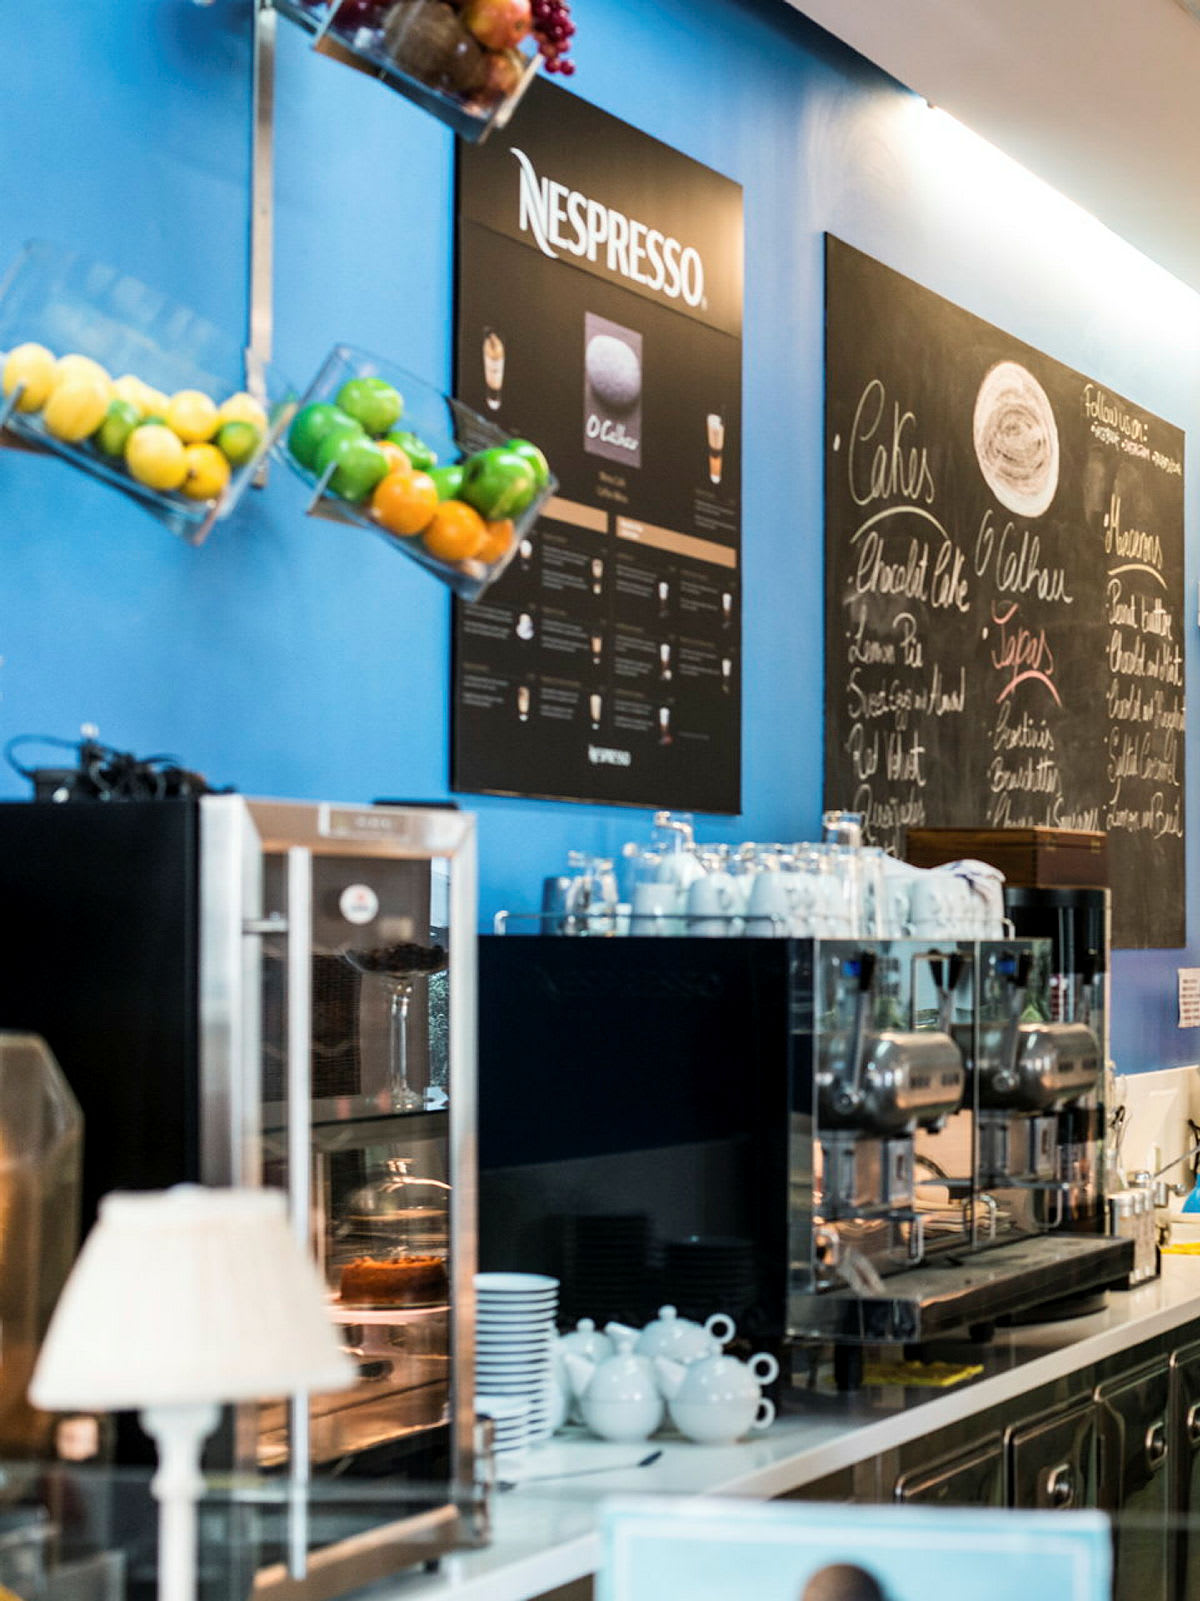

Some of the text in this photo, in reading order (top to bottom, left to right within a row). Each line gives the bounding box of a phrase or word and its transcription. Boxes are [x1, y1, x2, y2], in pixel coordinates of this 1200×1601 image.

[510, 147, 705, 308] NESPRESSO
[849, 379, 935, 505] Cakes
[1083, 383, 1118, 428] Follow
[1119, 413, 1131, 436] us
[931, 540, 970, 613] Cake
